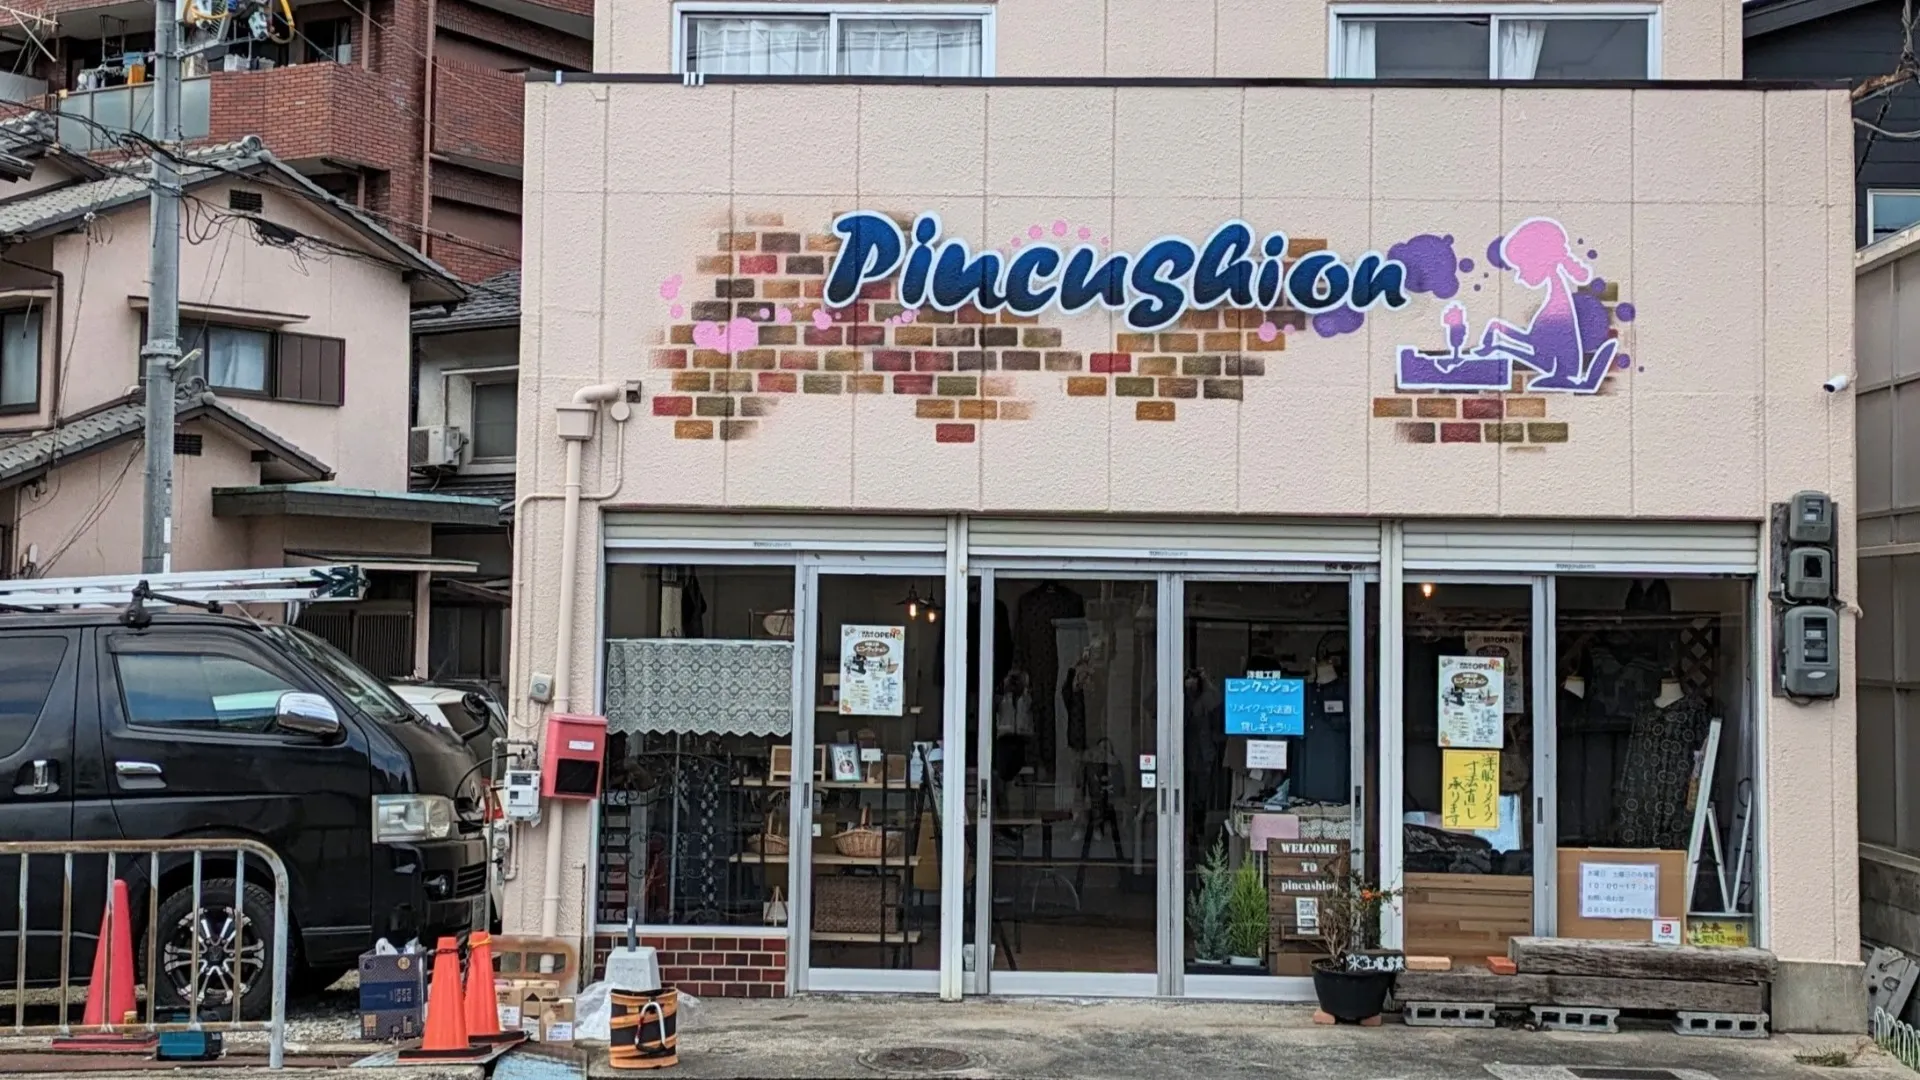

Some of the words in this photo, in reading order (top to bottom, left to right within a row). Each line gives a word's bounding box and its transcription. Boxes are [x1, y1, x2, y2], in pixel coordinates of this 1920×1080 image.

[823, 211, 1408, 332] Pincushion
[1472, 662, 1495, 671] OPEN
[1227, 679, 1301, 693] ピンクッション
[1260, 712, 1269, 723] &
[1481, 753, 1498, 823] 洋服リメイク
[1445, 776, 1466, 827] 承ります
[1281, 843, 1338, 854] WELCOME
[1301, 861, 1318, 873] TO
